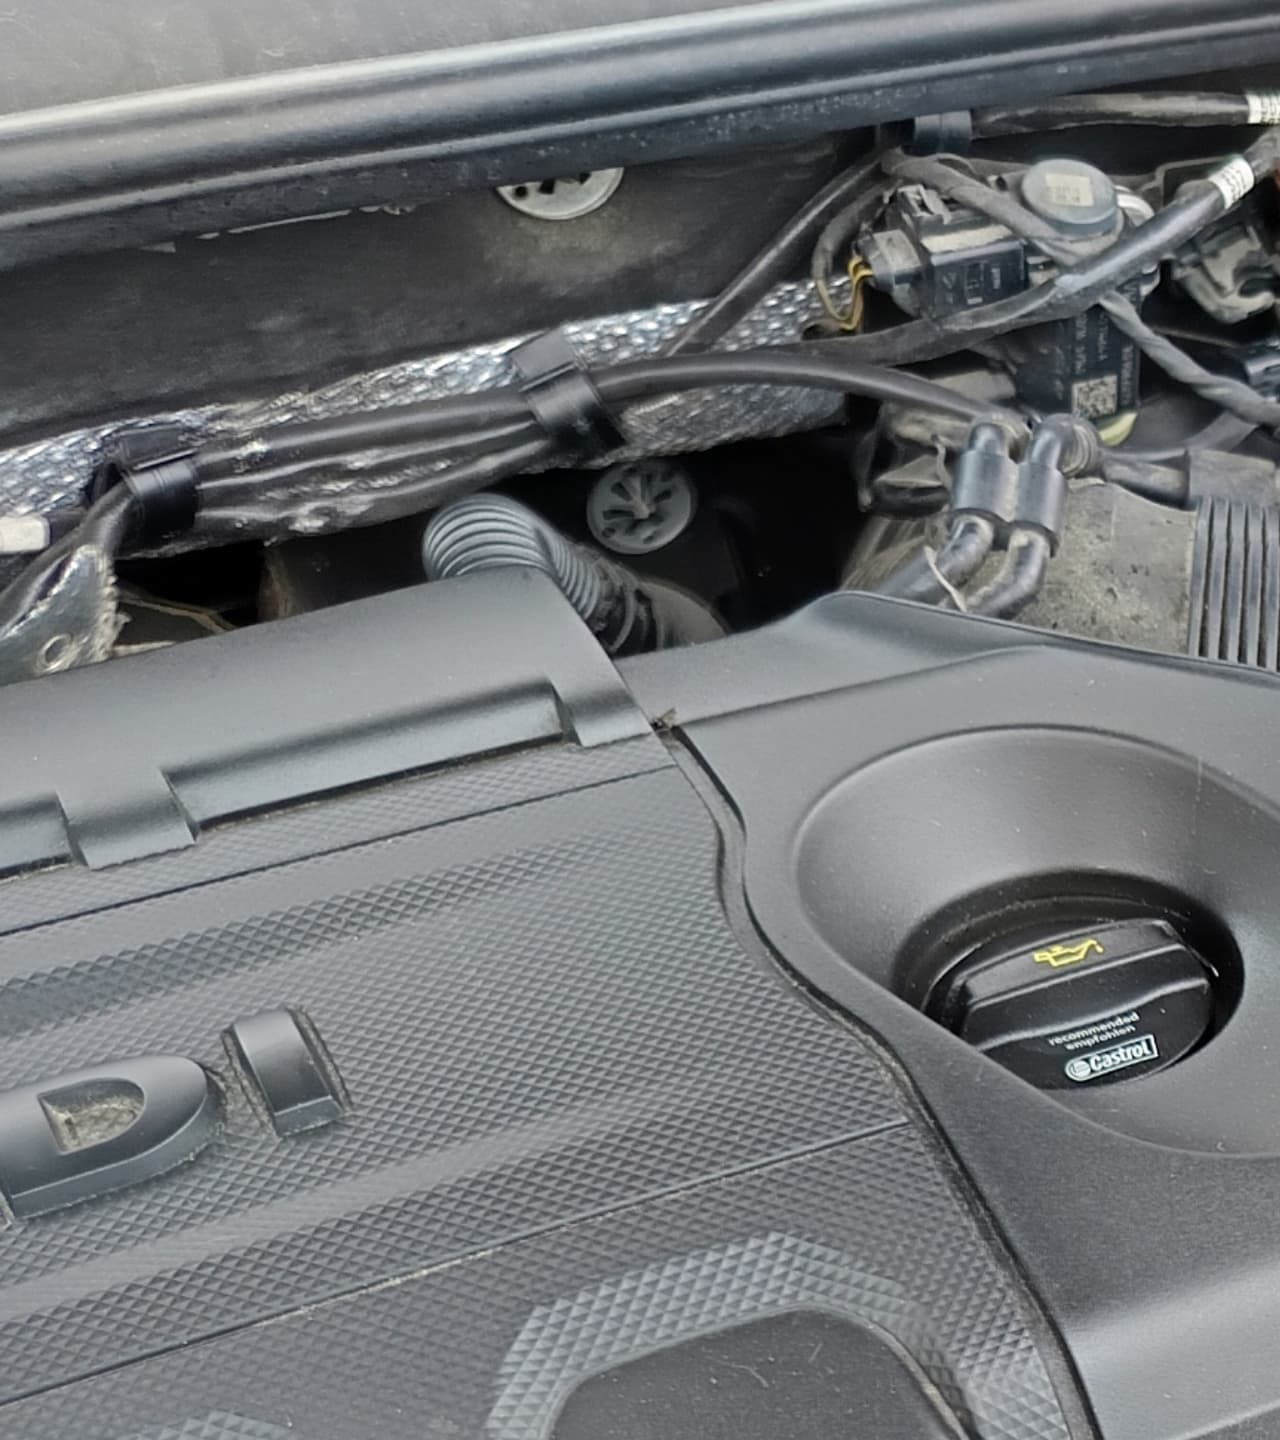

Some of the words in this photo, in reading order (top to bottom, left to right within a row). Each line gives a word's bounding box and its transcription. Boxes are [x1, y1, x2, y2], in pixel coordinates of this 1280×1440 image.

[1048, 1011, 1140, 1047] recommended
[1064, 1024, 1137, 1051] empfohlen
[1089, 1038, 1153, 1072] Castrol
